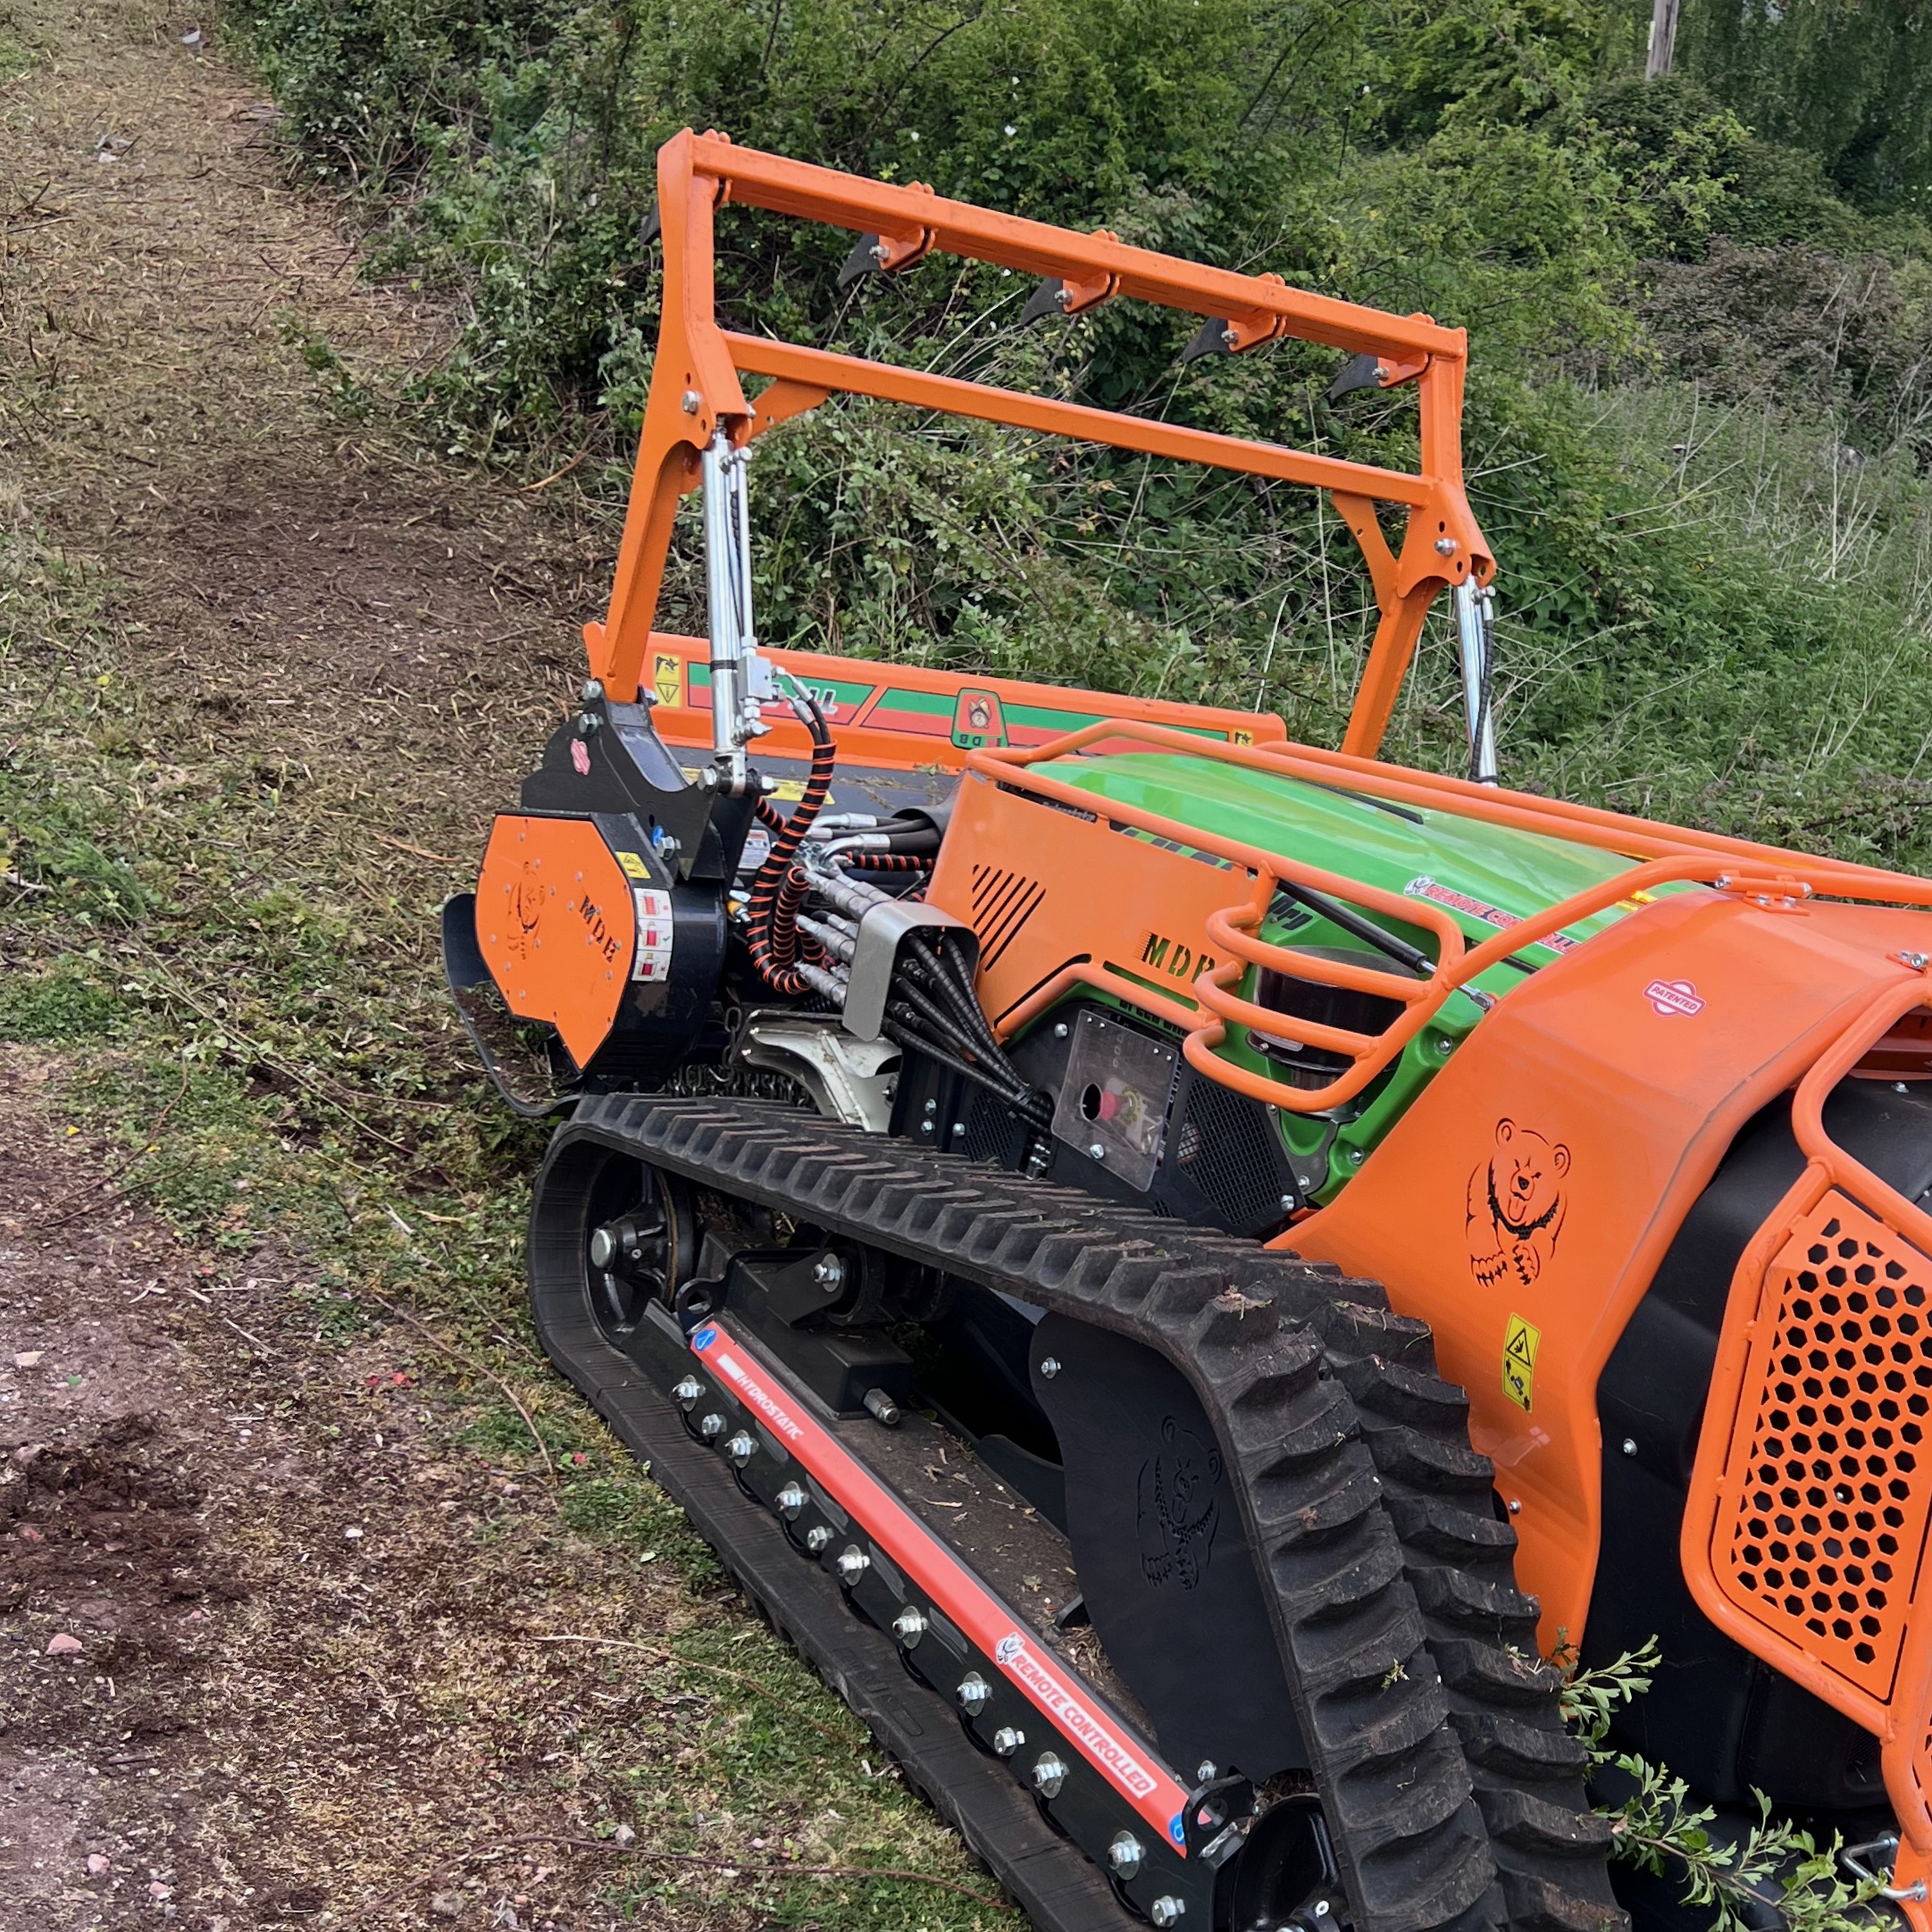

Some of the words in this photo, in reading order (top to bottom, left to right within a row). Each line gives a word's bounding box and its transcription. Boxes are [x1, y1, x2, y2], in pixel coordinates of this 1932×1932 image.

[1424, 884, 1493, 917] REMOTE
[1652, 985, 1698, 1010] PATENTED
[736, 1376, 804, 1440] HYDROSTATIC
[1011, 1655, 1067, 1708] REMOTE
[1064, 1706, 1151, 1792] CONTROLLED
